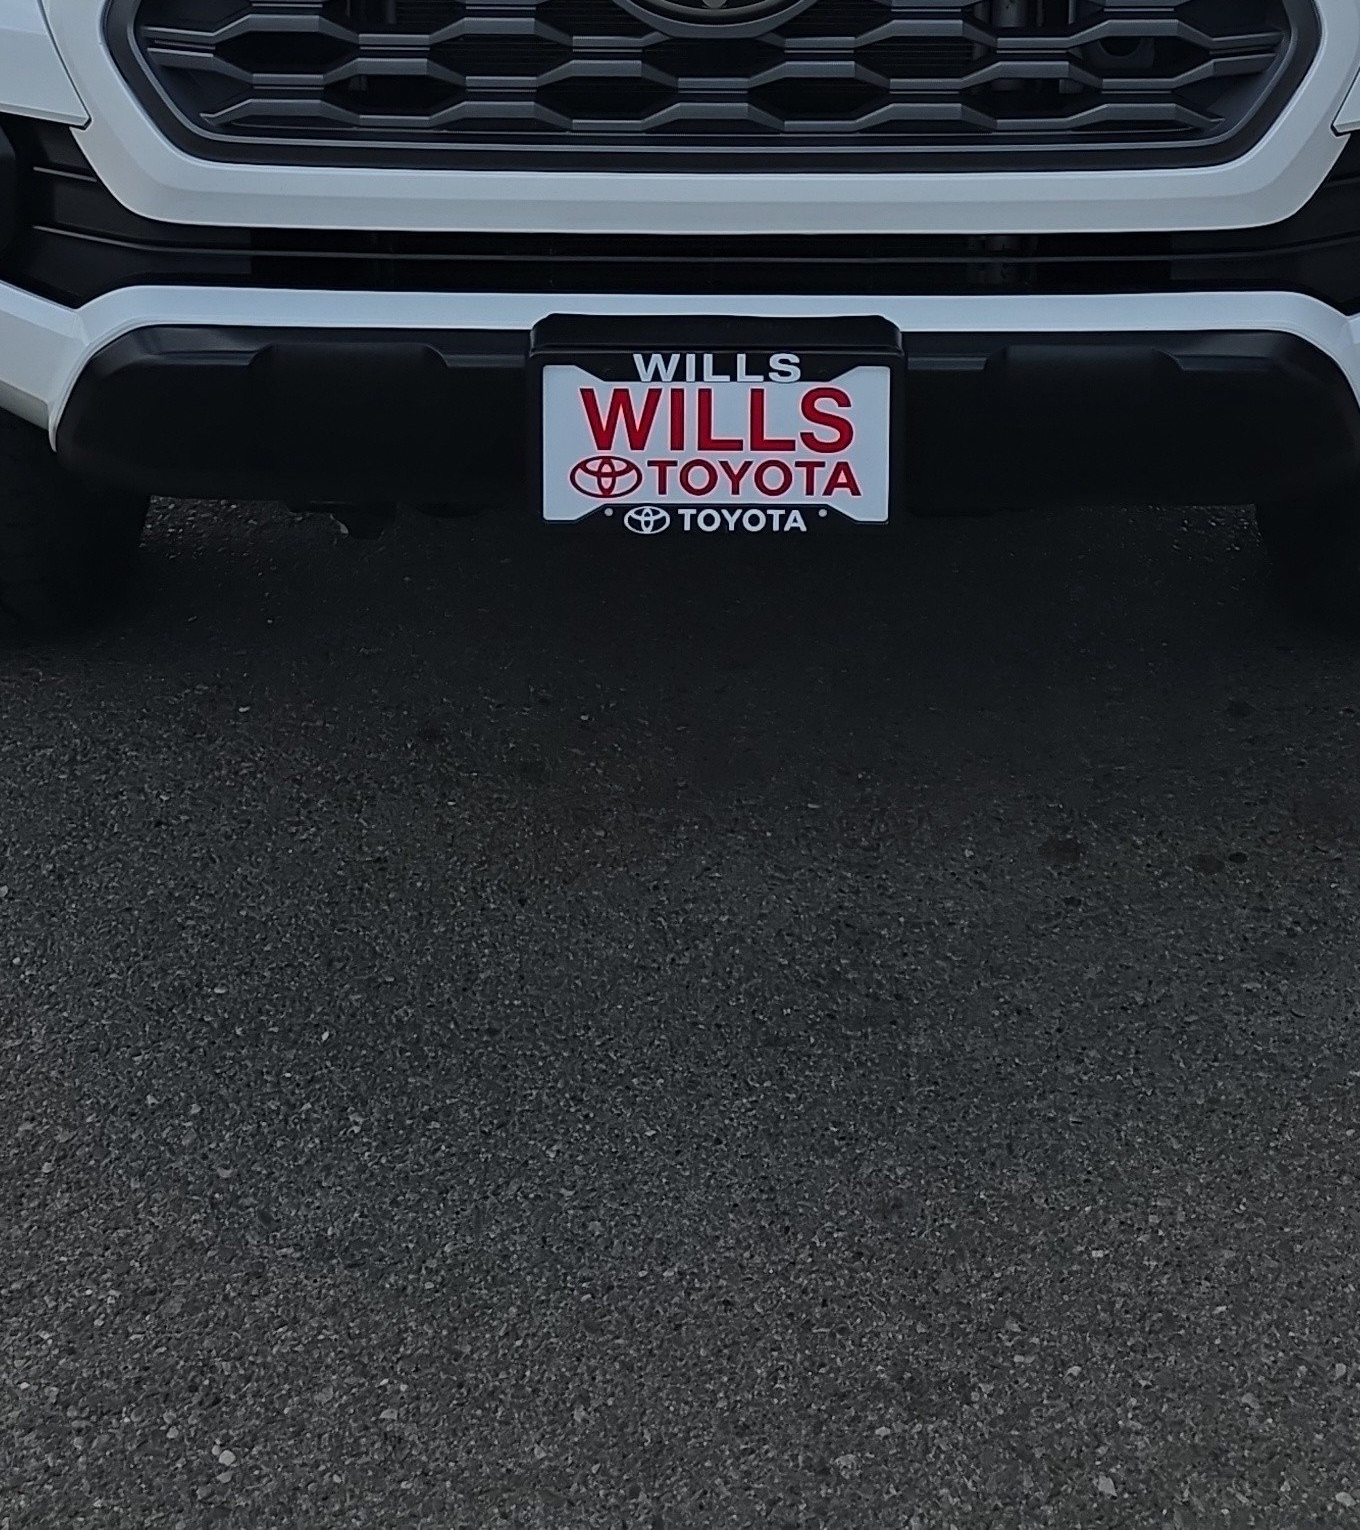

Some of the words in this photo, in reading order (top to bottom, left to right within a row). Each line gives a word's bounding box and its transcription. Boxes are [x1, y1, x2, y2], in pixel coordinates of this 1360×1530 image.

[633, 353, 801, 382] WILLS
[579, 387, 854, 454] WILLS
[647, 459, 862, 496] TOYOTA
[678, 509, 807, 532] TOYOTA
